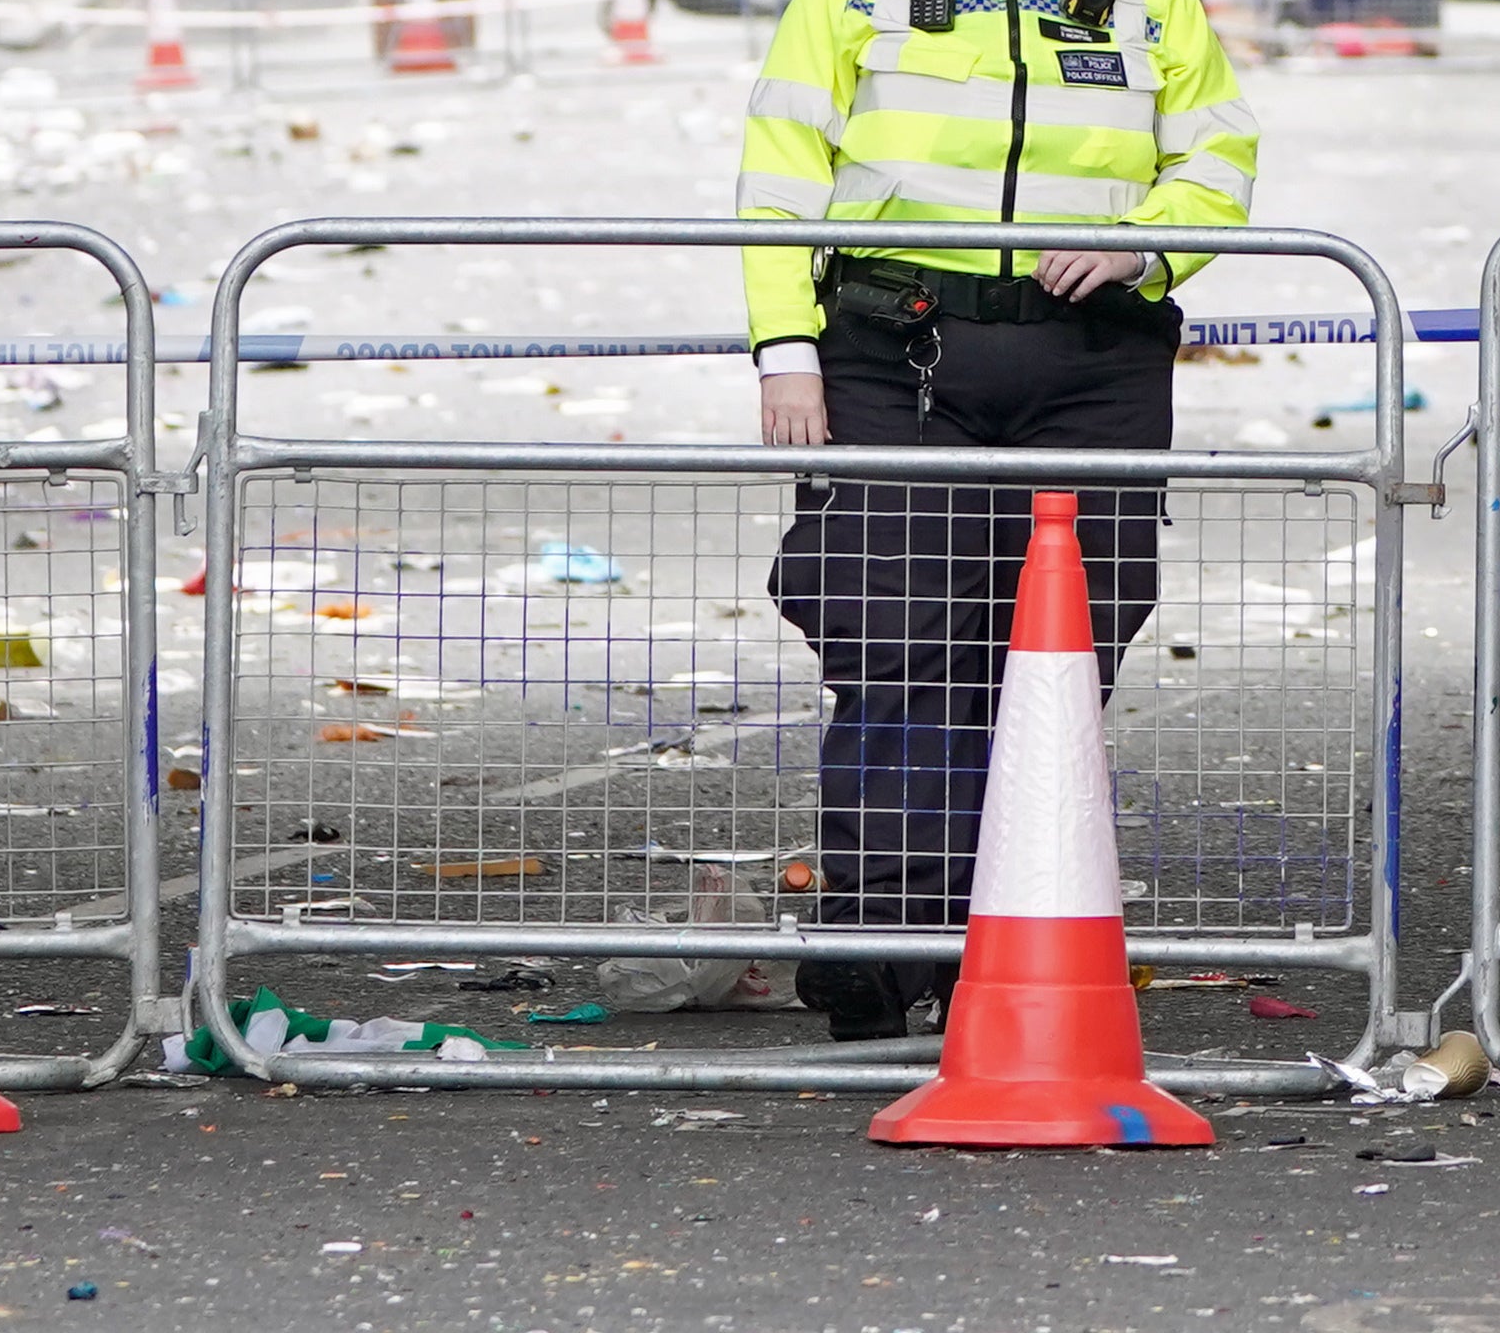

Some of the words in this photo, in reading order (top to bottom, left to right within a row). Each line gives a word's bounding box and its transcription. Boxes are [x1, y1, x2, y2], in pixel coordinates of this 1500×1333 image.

[1088, 60, 1112, 70] POLICE
[1066, 71, 1093, 80] POLICE
[1093, 72, 1124, 82] OFFICER
